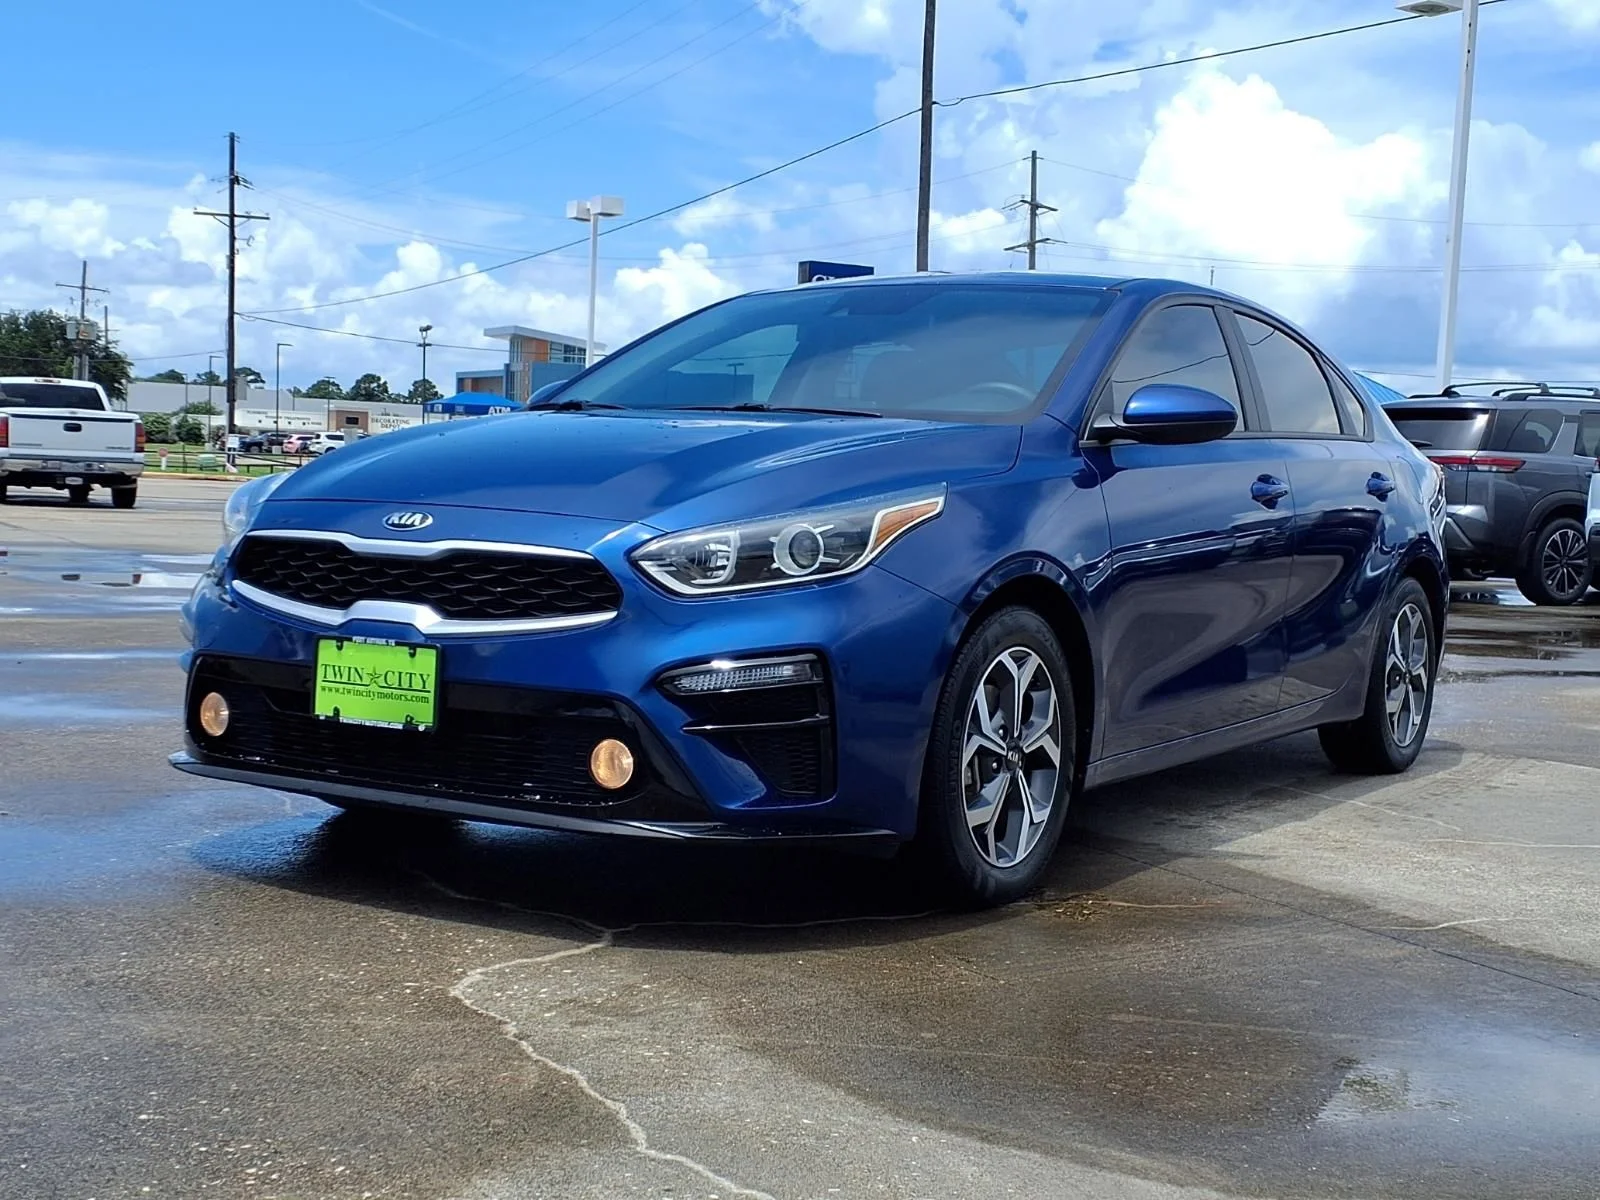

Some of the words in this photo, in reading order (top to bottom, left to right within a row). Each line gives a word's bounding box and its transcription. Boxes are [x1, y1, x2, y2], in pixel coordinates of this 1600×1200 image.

[488, 406, 511, 415] ATM
[387, 511, 424, 526] KIA
[321, 663, 364, 682] TWIN
[384, 669, 430, 689] CITY
[320, 685, 430, 704] www.twincitymotors.com
